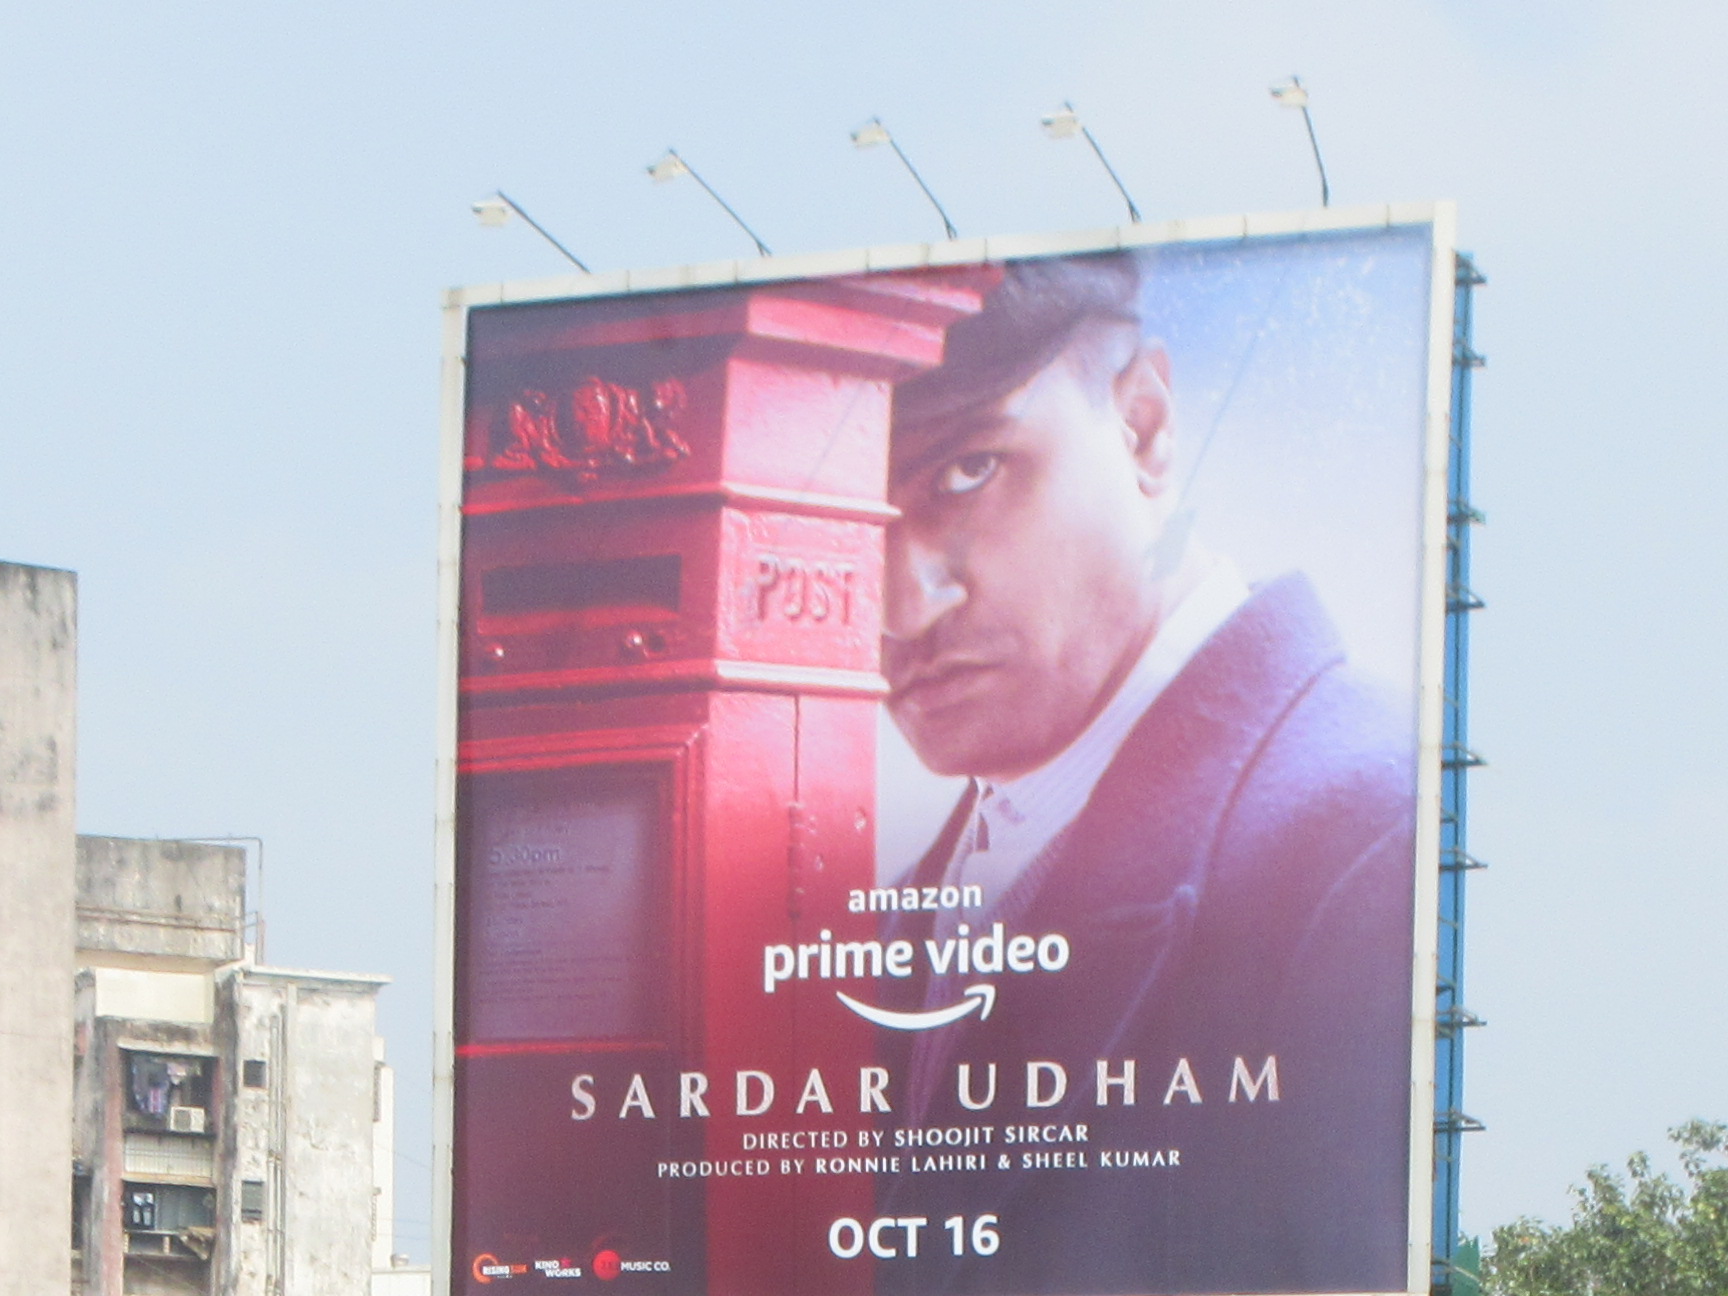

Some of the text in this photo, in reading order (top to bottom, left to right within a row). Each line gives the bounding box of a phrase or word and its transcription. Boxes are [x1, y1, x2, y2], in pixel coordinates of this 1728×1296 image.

[755, 553, 854, 624] POST
[848, 884, 983, 912] amazon
[762, 922, 1070, 992] prime video
[571, 1055, 1282, 1121] SARDAR UDHAM
[743, 1124, 1089, 1150] DIRECTED BY SHOOJIT SIRCAR
[657, 1149, 1181, 1178] PRODUCED BY RONNIE LAHIRI & SHEEL KUMAR
[827, 1213, 1001, 1259] OCT 16
[545, 1267, 582, 1278] WORKS
[620, 1261, 652, 1272] MUSIC
